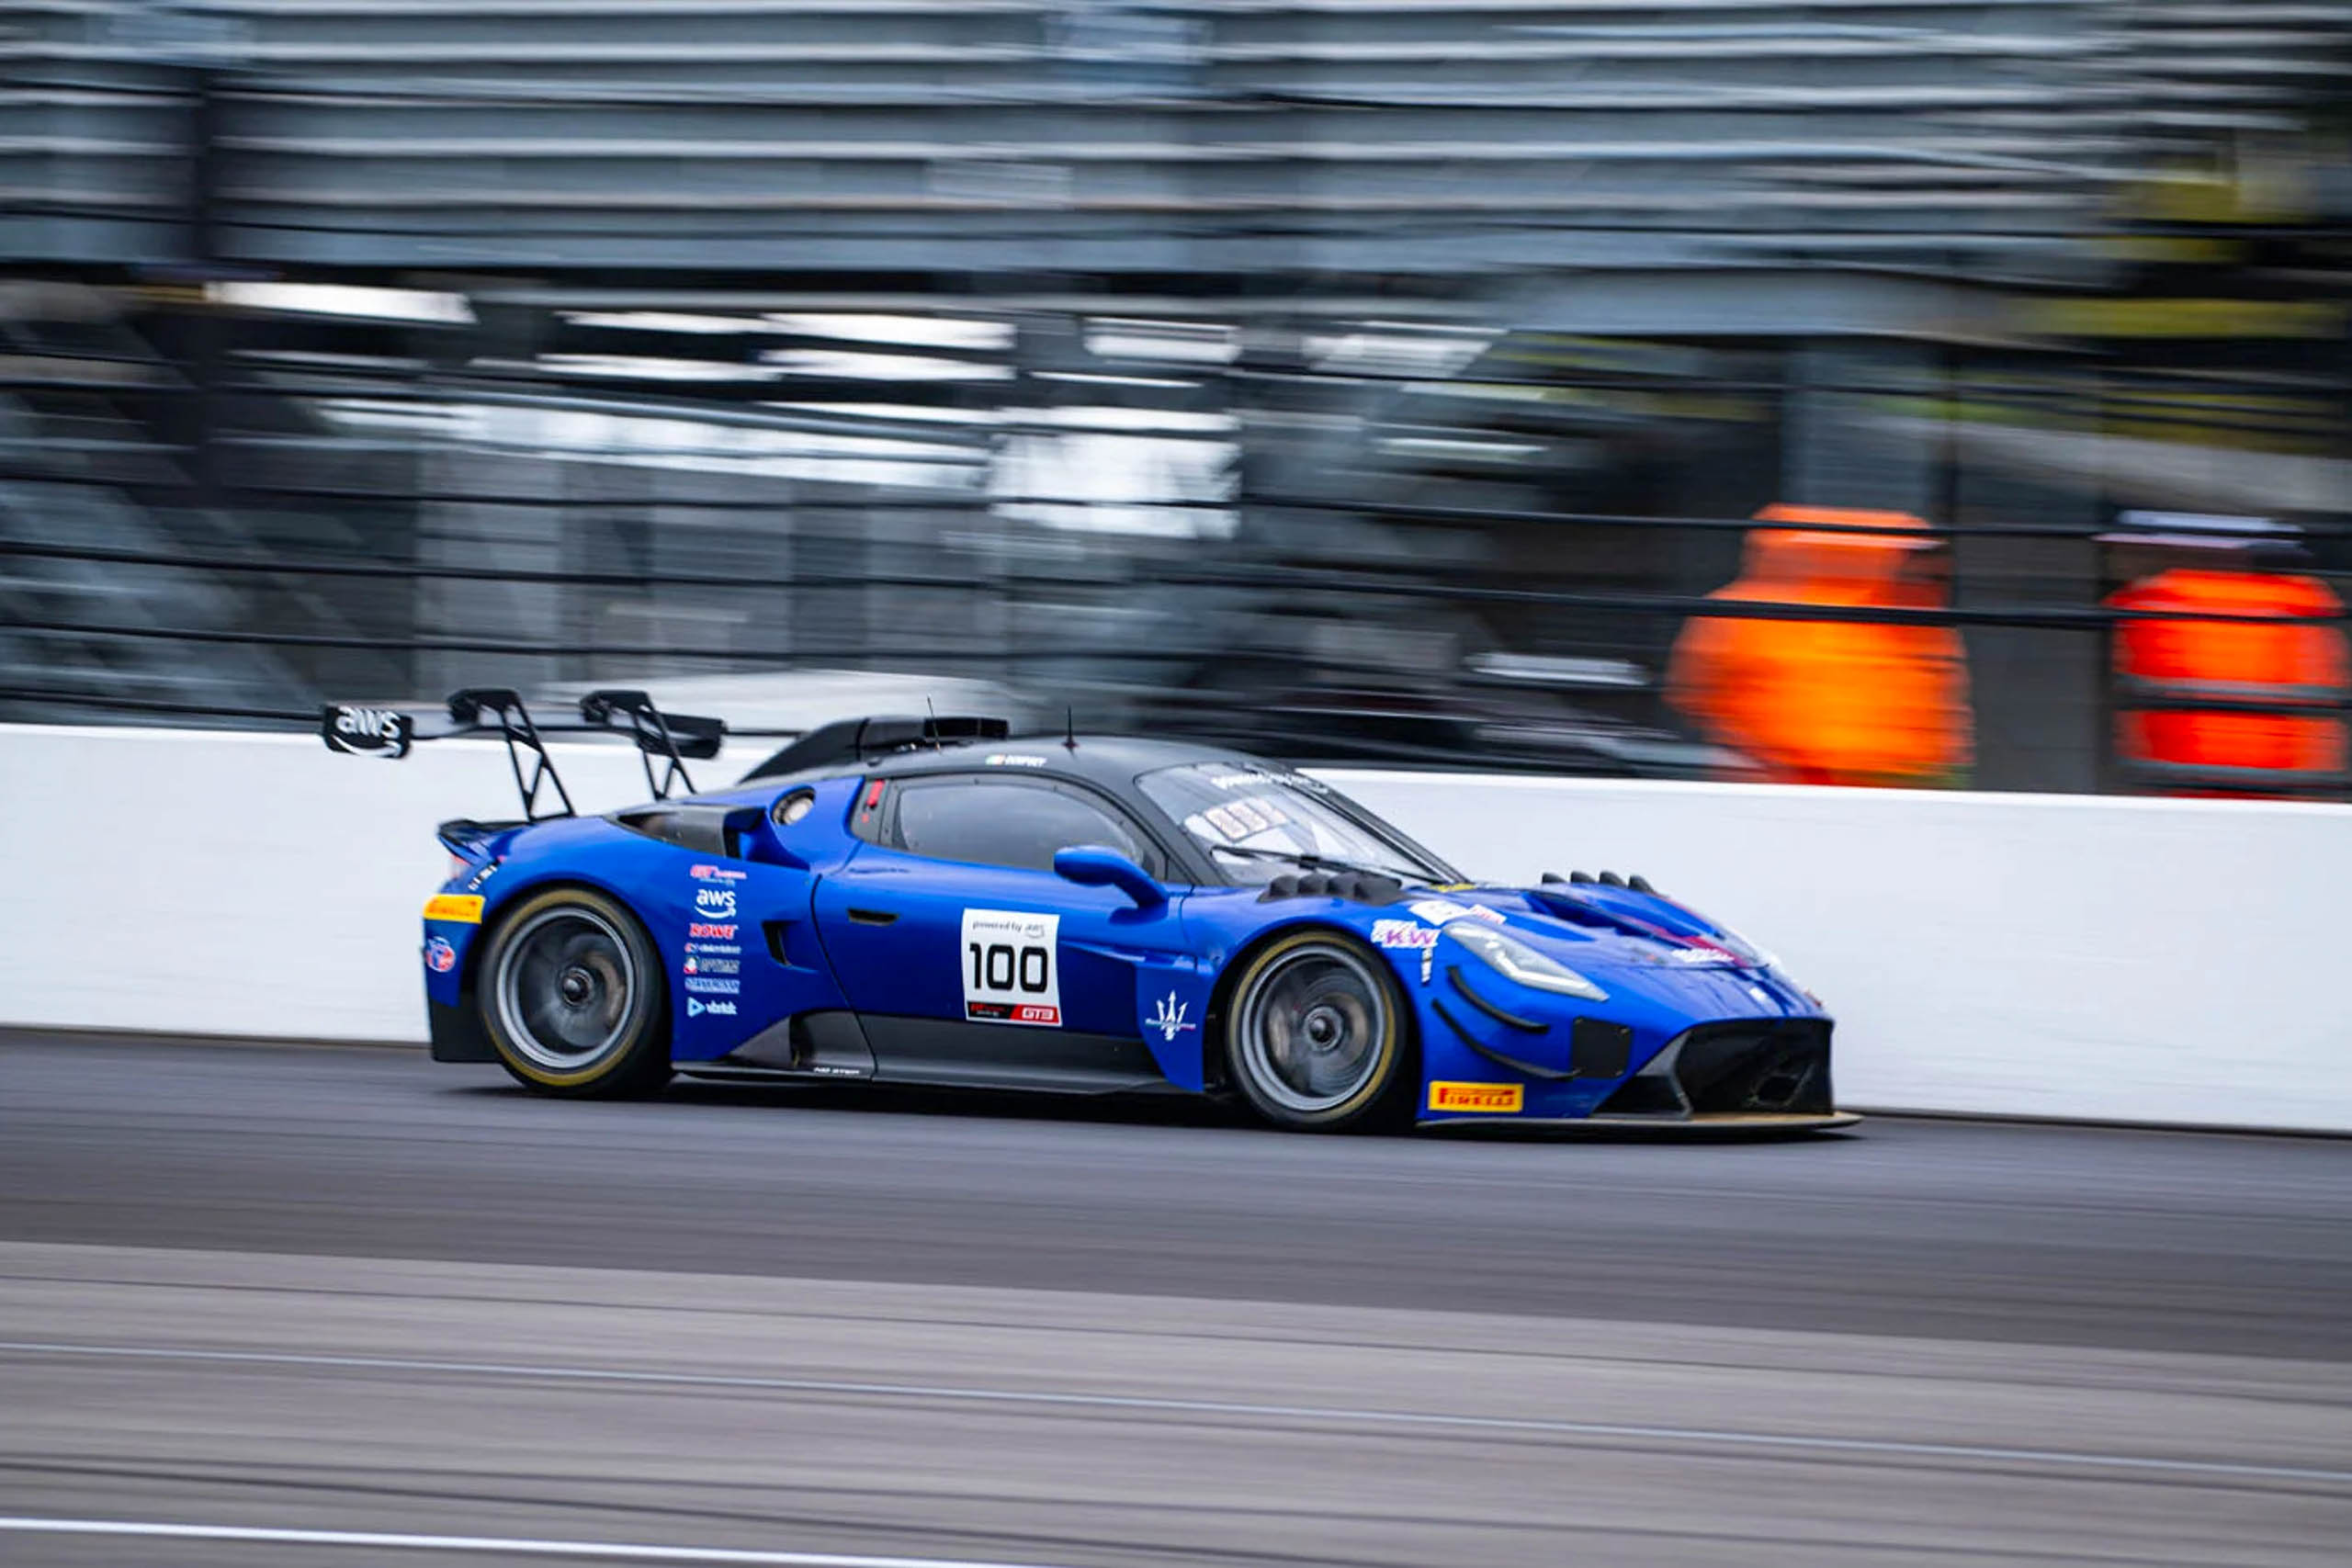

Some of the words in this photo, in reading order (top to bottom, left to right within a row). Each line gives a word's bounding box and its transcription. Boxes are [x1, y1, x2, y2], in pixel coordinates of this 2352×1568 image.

[336, 706, 401, 739] aws
[696, 889, 736, 907] aws
[1011, 922, 1023, 931] by
[1386, 929, 1438, 945] KW
[969, 942, 1047, 993] 100
[1439, 1088, 1514, 1105] PIRELLI
